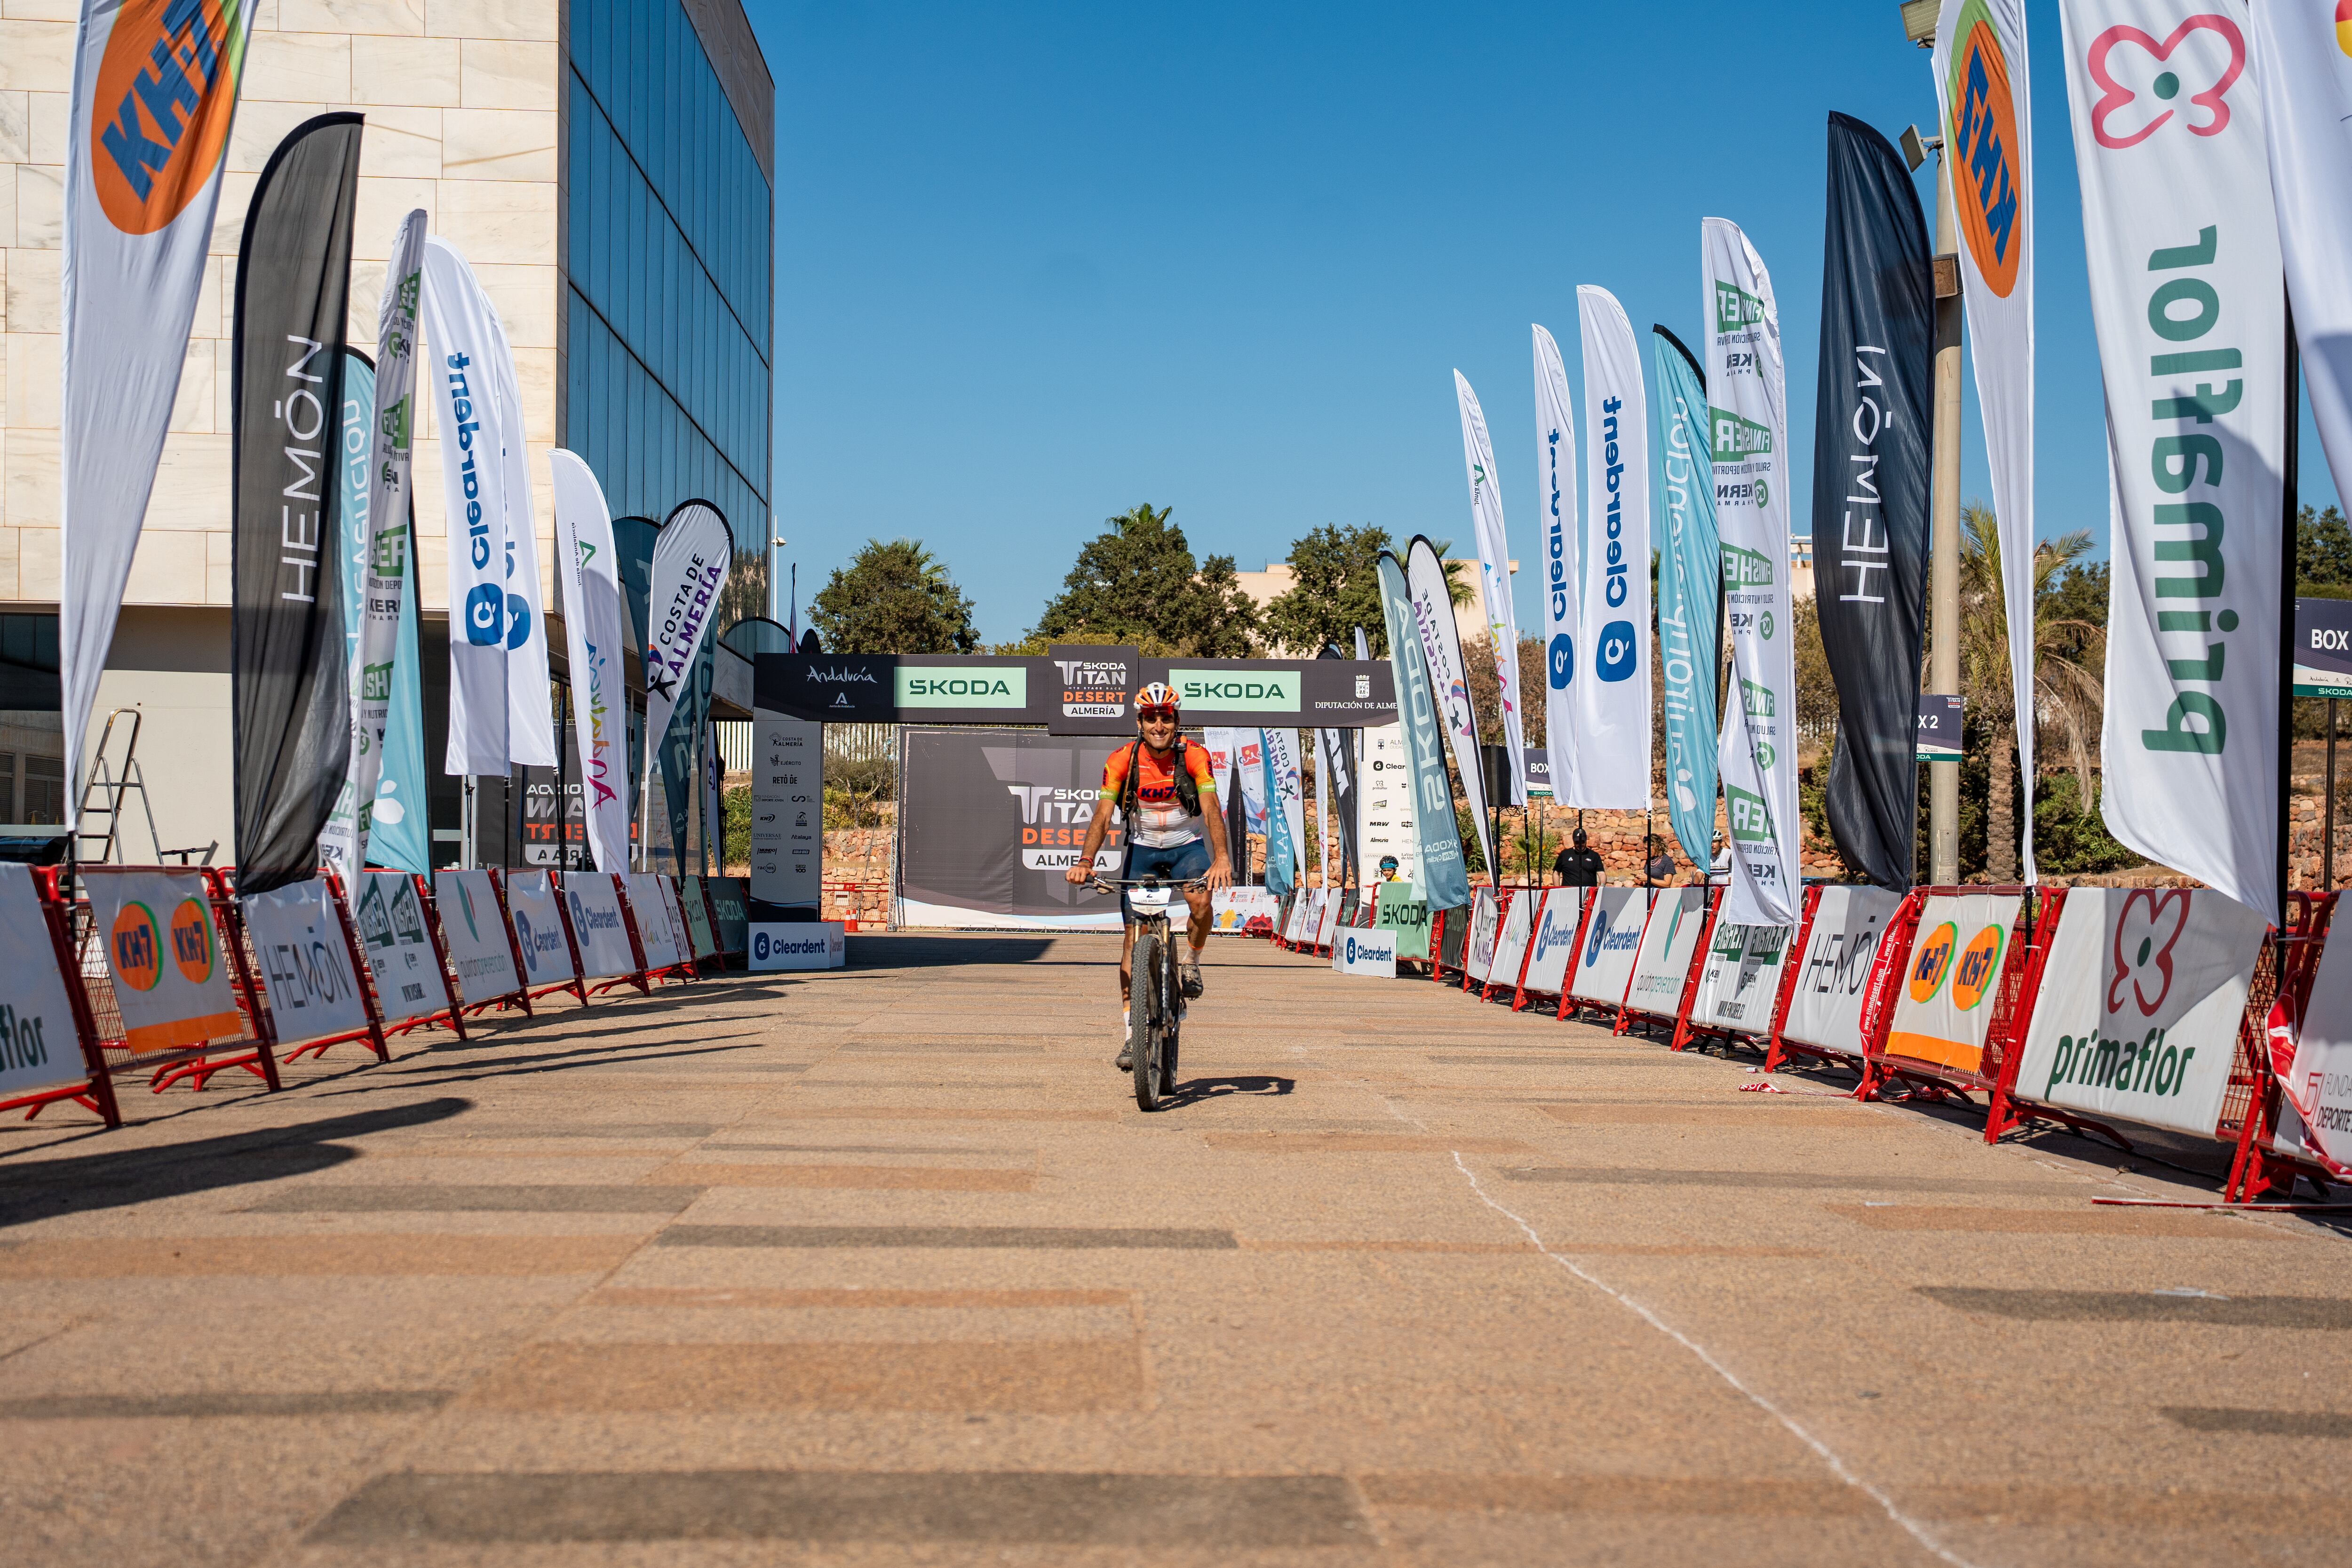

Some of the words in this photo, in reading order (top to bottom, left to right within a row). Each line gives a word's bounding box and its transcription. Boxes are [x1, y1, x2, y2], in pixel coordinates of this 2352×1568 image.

[660, 583, 693, 646] COSTA
[686, 553, 704, 581] DE
[667, 567, 722, 678] ALMERÍA
[2312, 629, 2349, 650] BOX
[1054, 661, 1126, 685] TITAN
[1064, 692, 1126, 702] DESERT
[1315, 700, 1363, 709] DIPUTACIÓN
[1071, 706, 1115, 715] ALMERÍA
[1930, 715, 1938, 729] 2
[1022, 828, 1122, 846] DESET
[1035, 854, 1107, 868] ALMEA
[585, 907, 620, 931] Cleardent
[1548, 923, 1575, 947] Cleardent
[1603, 925, 1641, 950] Cleardent
[773, 939, 825, 954] Cleardent
[1358, 945, 1391, 961] Cleardent
[1864, 968, 1885, 1030] www.titandesert.com
[2045, 1028, 2195, 1102] primaflor
